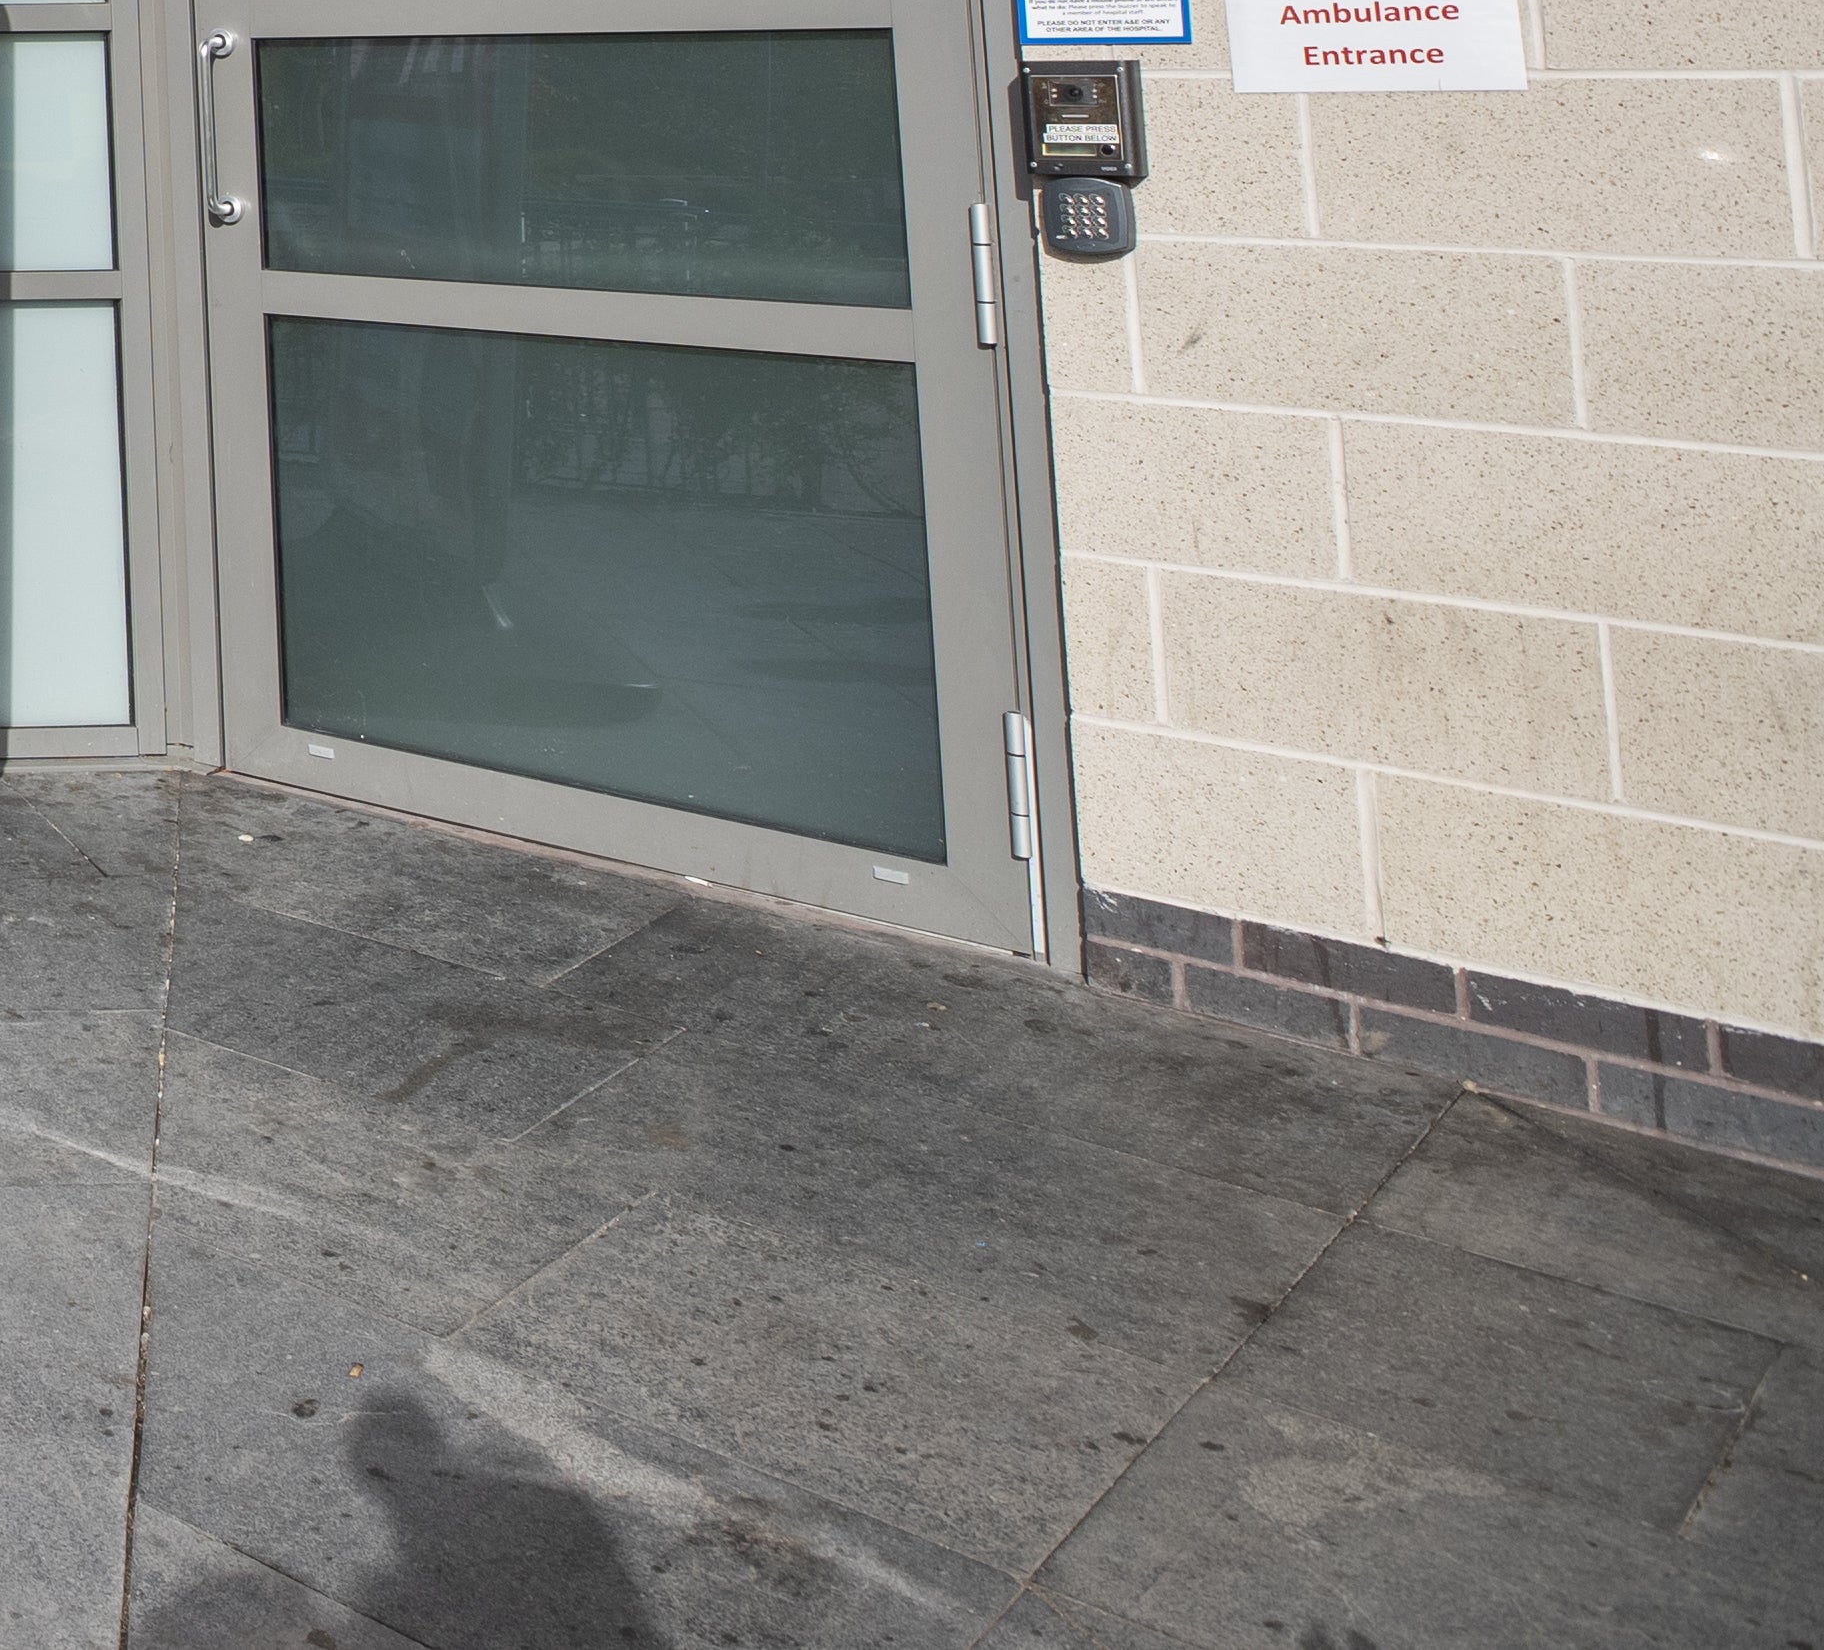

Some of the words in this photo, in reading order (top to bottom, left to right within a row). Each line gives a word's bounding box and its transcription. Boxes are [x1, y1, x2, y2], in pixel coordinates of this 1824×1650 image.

[1280, 1, 1460, 25] Ambulance
[1303, 46, 1445, 66] Entrance
[1048, 125, 1083, 133] PLEASE
[1085, 125, 1117, 133] PRESS
[1046, 134, 1082, 142] BUTTON
[1084, 134, 1117, 142] BELOW
